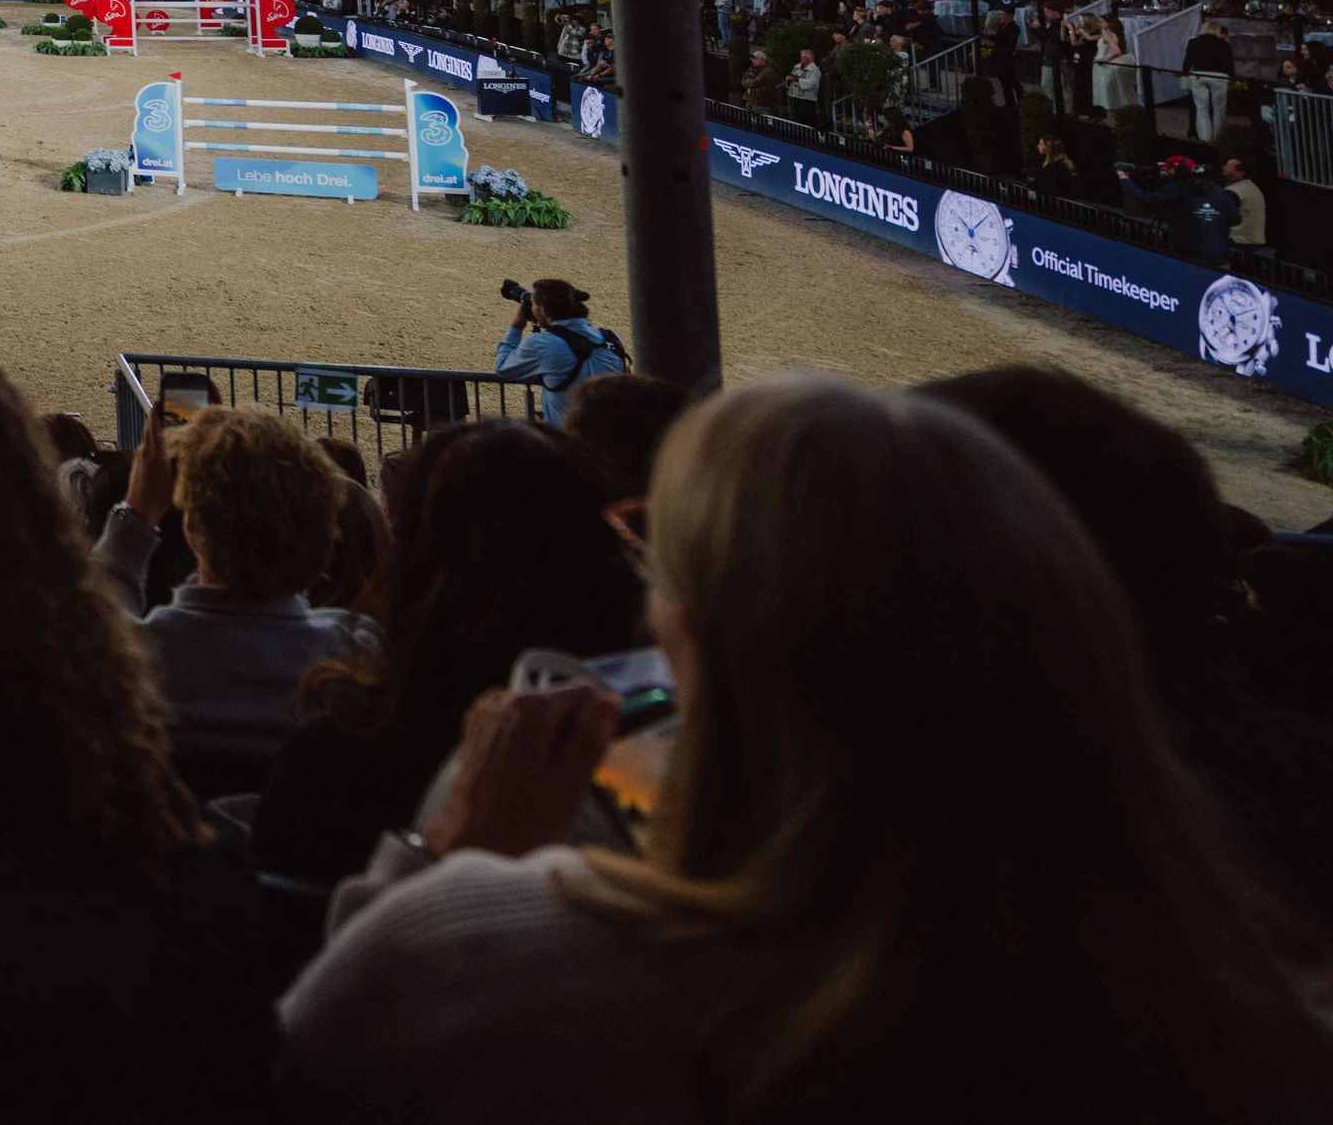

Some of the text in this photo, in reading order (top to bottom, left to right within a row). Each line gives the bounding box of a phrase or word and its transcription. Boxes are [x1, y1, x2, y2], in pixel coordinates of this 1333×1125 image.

[361, 32, 395, 56] LONGINES
[427, 49, 473, 82] LONGINES
[483, 82, 527, 90] LONGINES
[143, 99, 172, 132] 3
[419, 110, 453, 146] 3
[142, 157, 173, 168] drei.at
[237, 169, 353, 188] Lebe hoch Drei.
[422, 173, 458, 184] drei.at
[793, 161, 920, 232] LONGINES
[1031, 246, 1180, 313] Official Timekeeper
